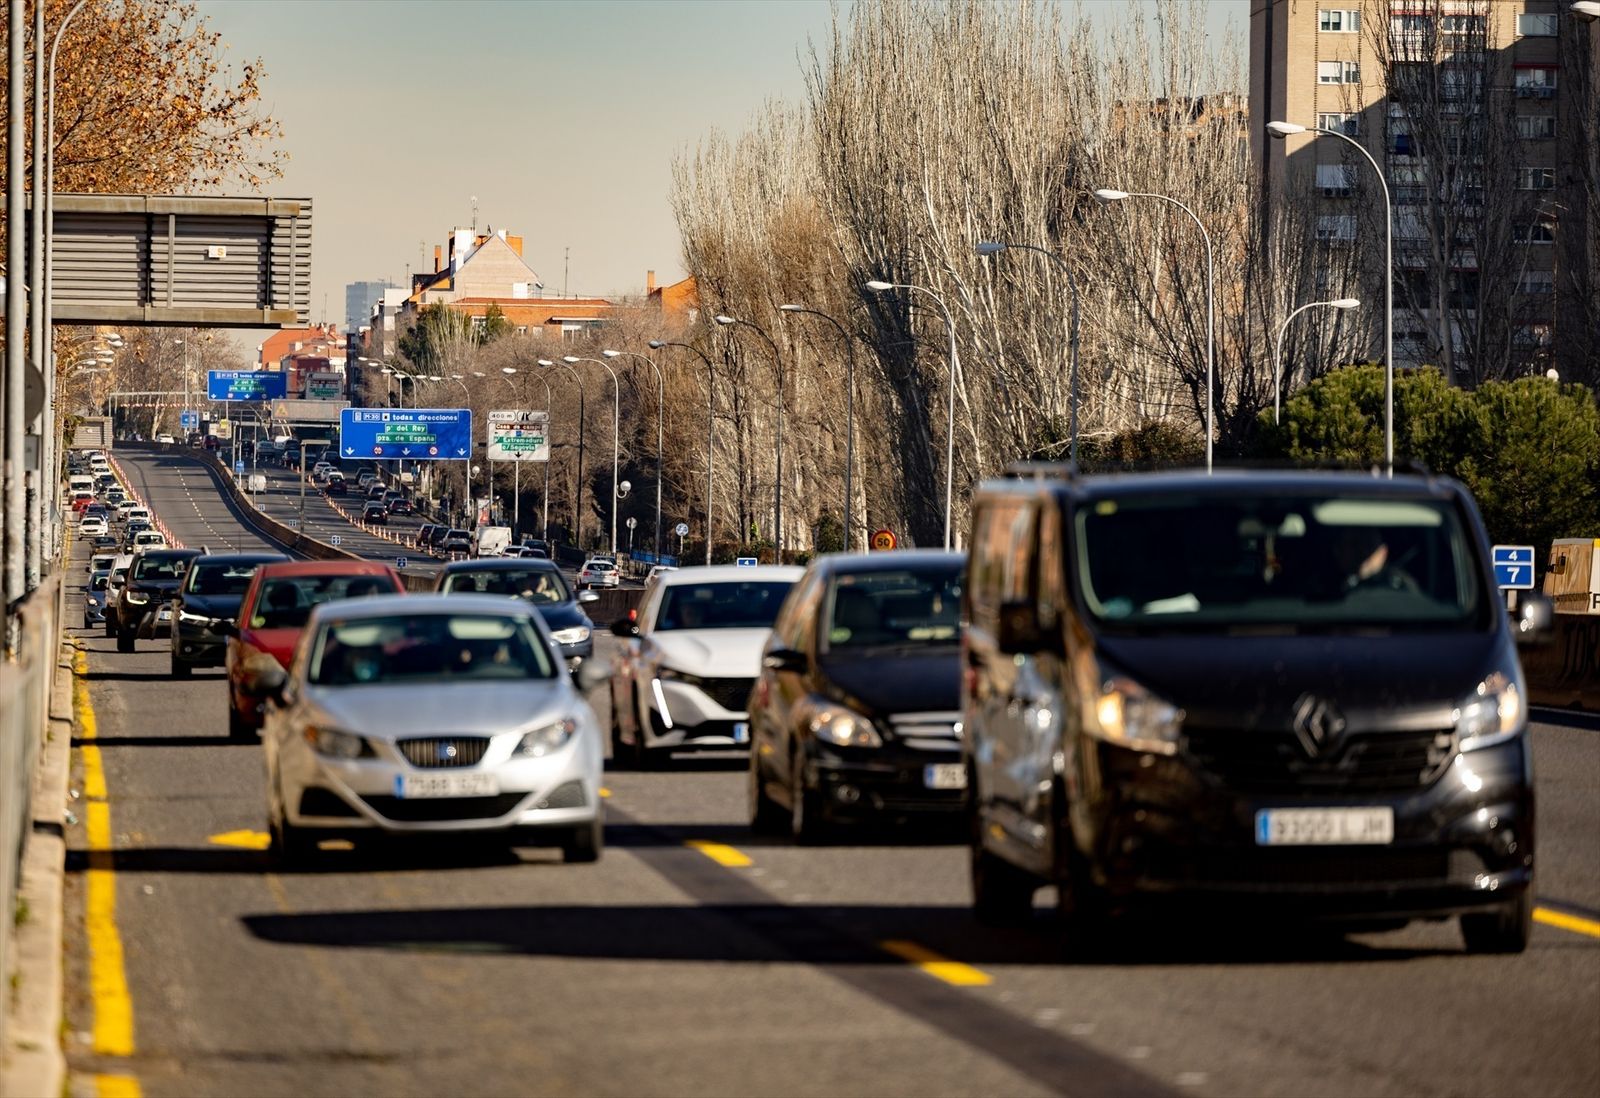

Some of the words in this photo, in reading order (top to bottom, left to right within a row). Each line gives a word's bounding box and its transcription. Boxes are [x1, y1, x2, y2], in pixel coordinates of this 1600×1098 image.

[878, 538, 890, 546] 50
[1508, 550, 1518, 560] 4
[1507, 566, 1520, 583] 7
